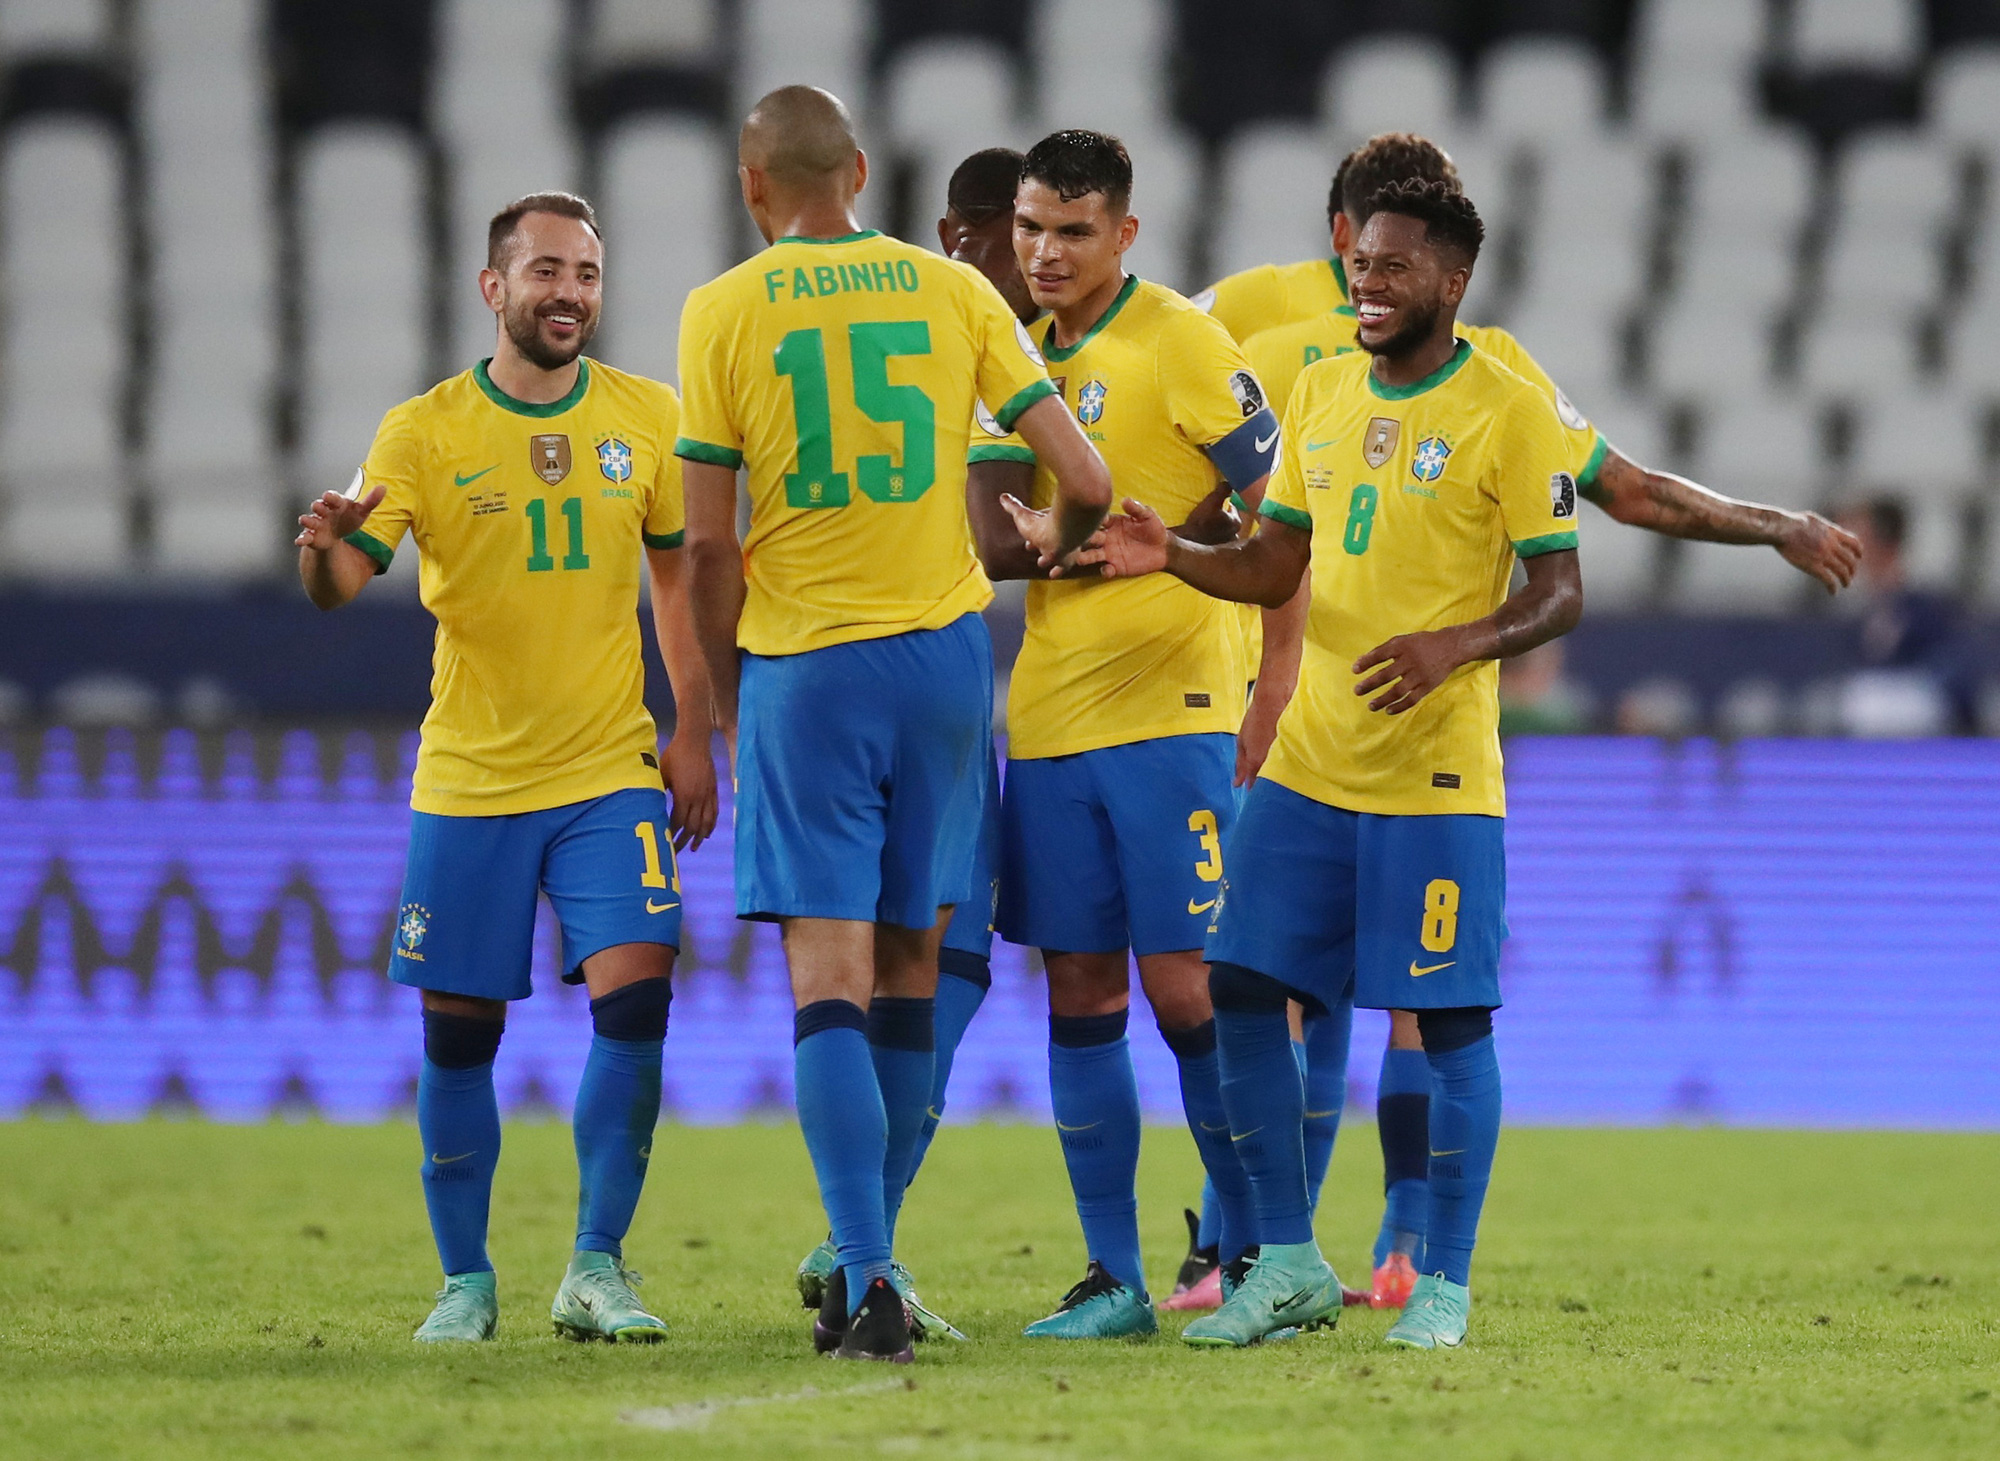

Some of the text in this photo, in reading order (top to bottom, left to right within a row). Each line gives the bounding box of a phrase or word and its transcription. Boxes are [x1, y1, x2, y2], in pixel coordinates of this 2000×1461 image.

[764, 259, 919, 303] FABINHO
[773, 320, 935, 508] 15
[601, 488, 635, 499] BRASIL
[1342, 483, 1378, 555] 8
[1403, 484, 1438, 499] BRASIL
[525, 497, 589, 571] 11
[1188, 809, 1224, 882] 3
[1420, 878, 1460, 953] 8
[397, 947, 425, 962] BRASIL
